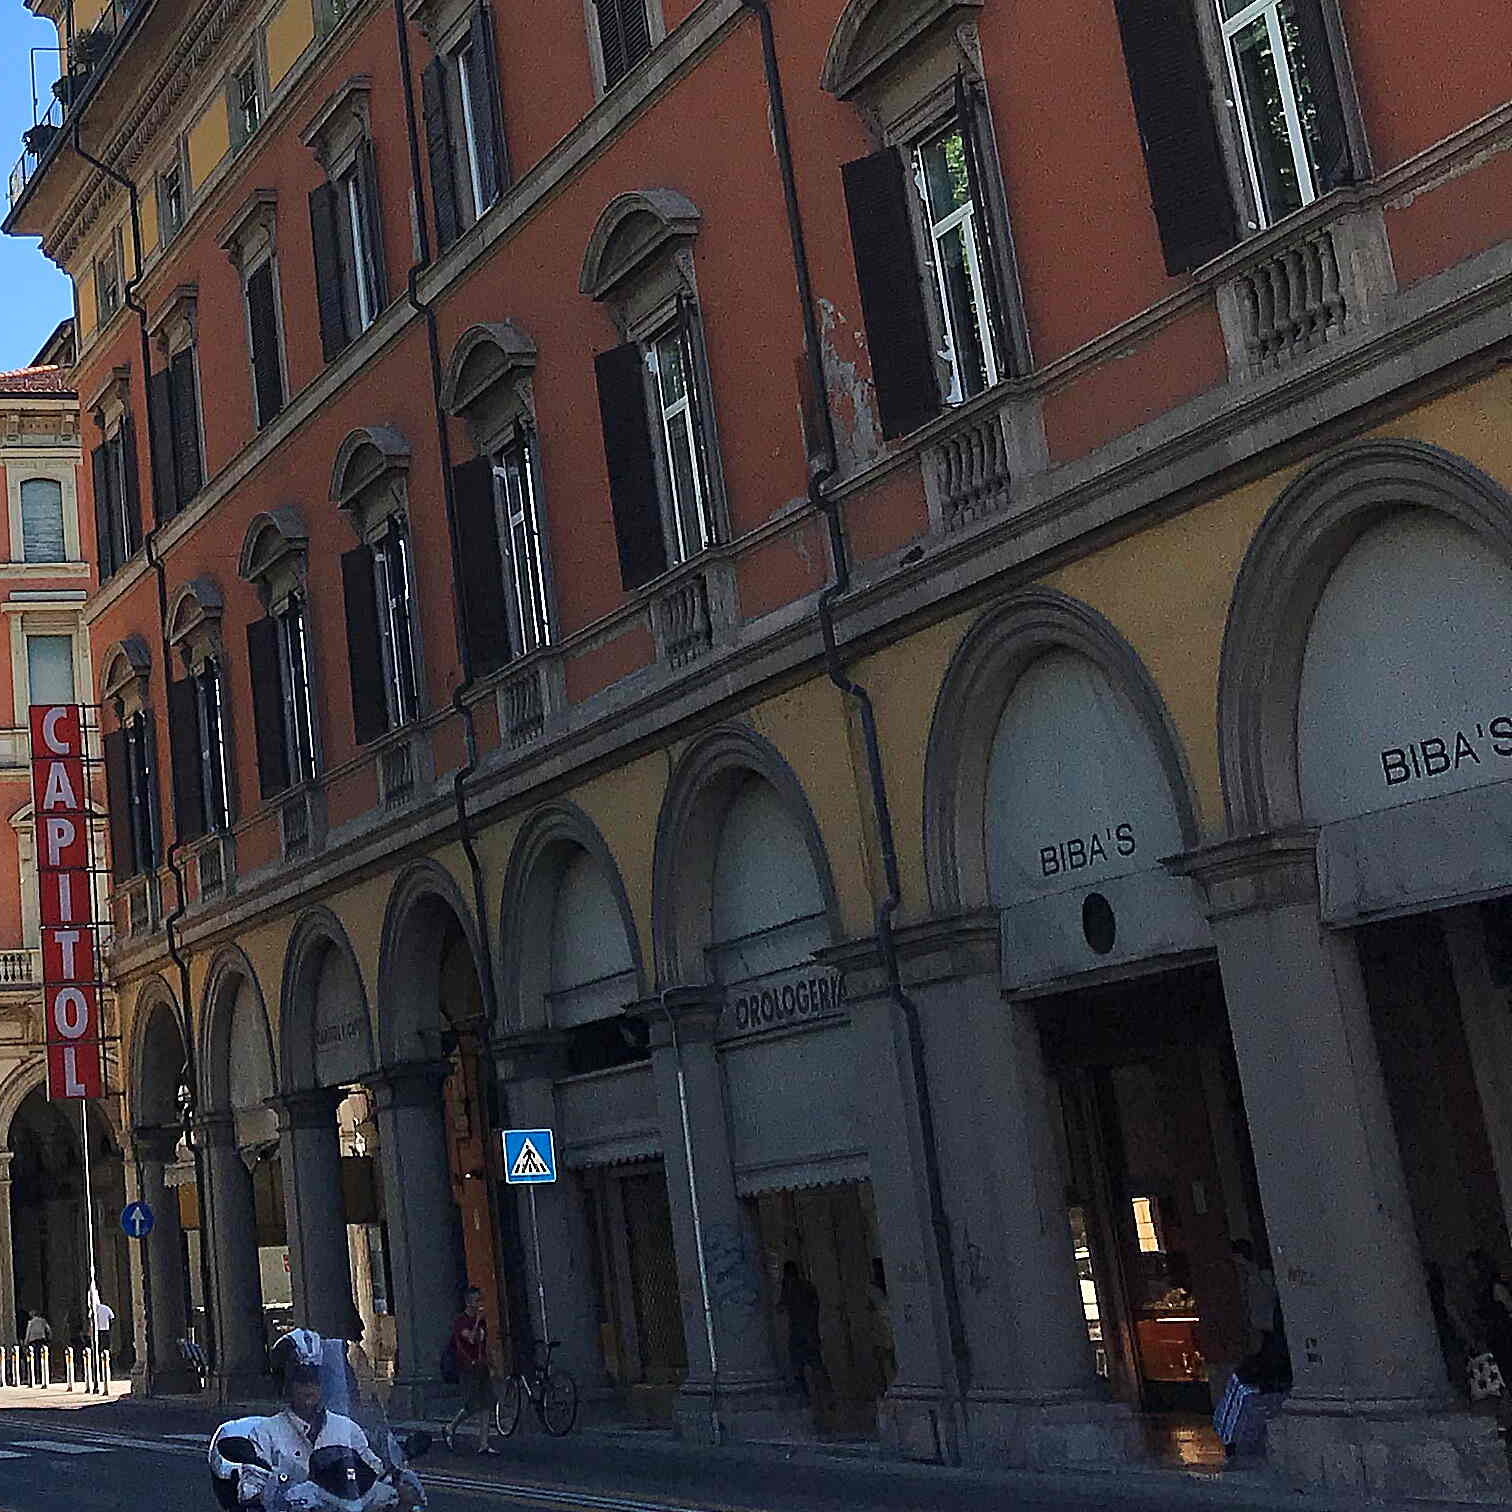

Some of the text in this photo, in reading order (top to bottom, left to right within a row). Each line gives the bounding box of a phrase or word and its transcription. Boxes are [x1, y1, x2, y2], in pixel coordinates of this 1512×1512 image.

[1380, 716, 1512, 786] BIBA'S
[1039, 823, 1137, 877] BIBA'S
[42, 706, 89, 1098] CAPITOL
